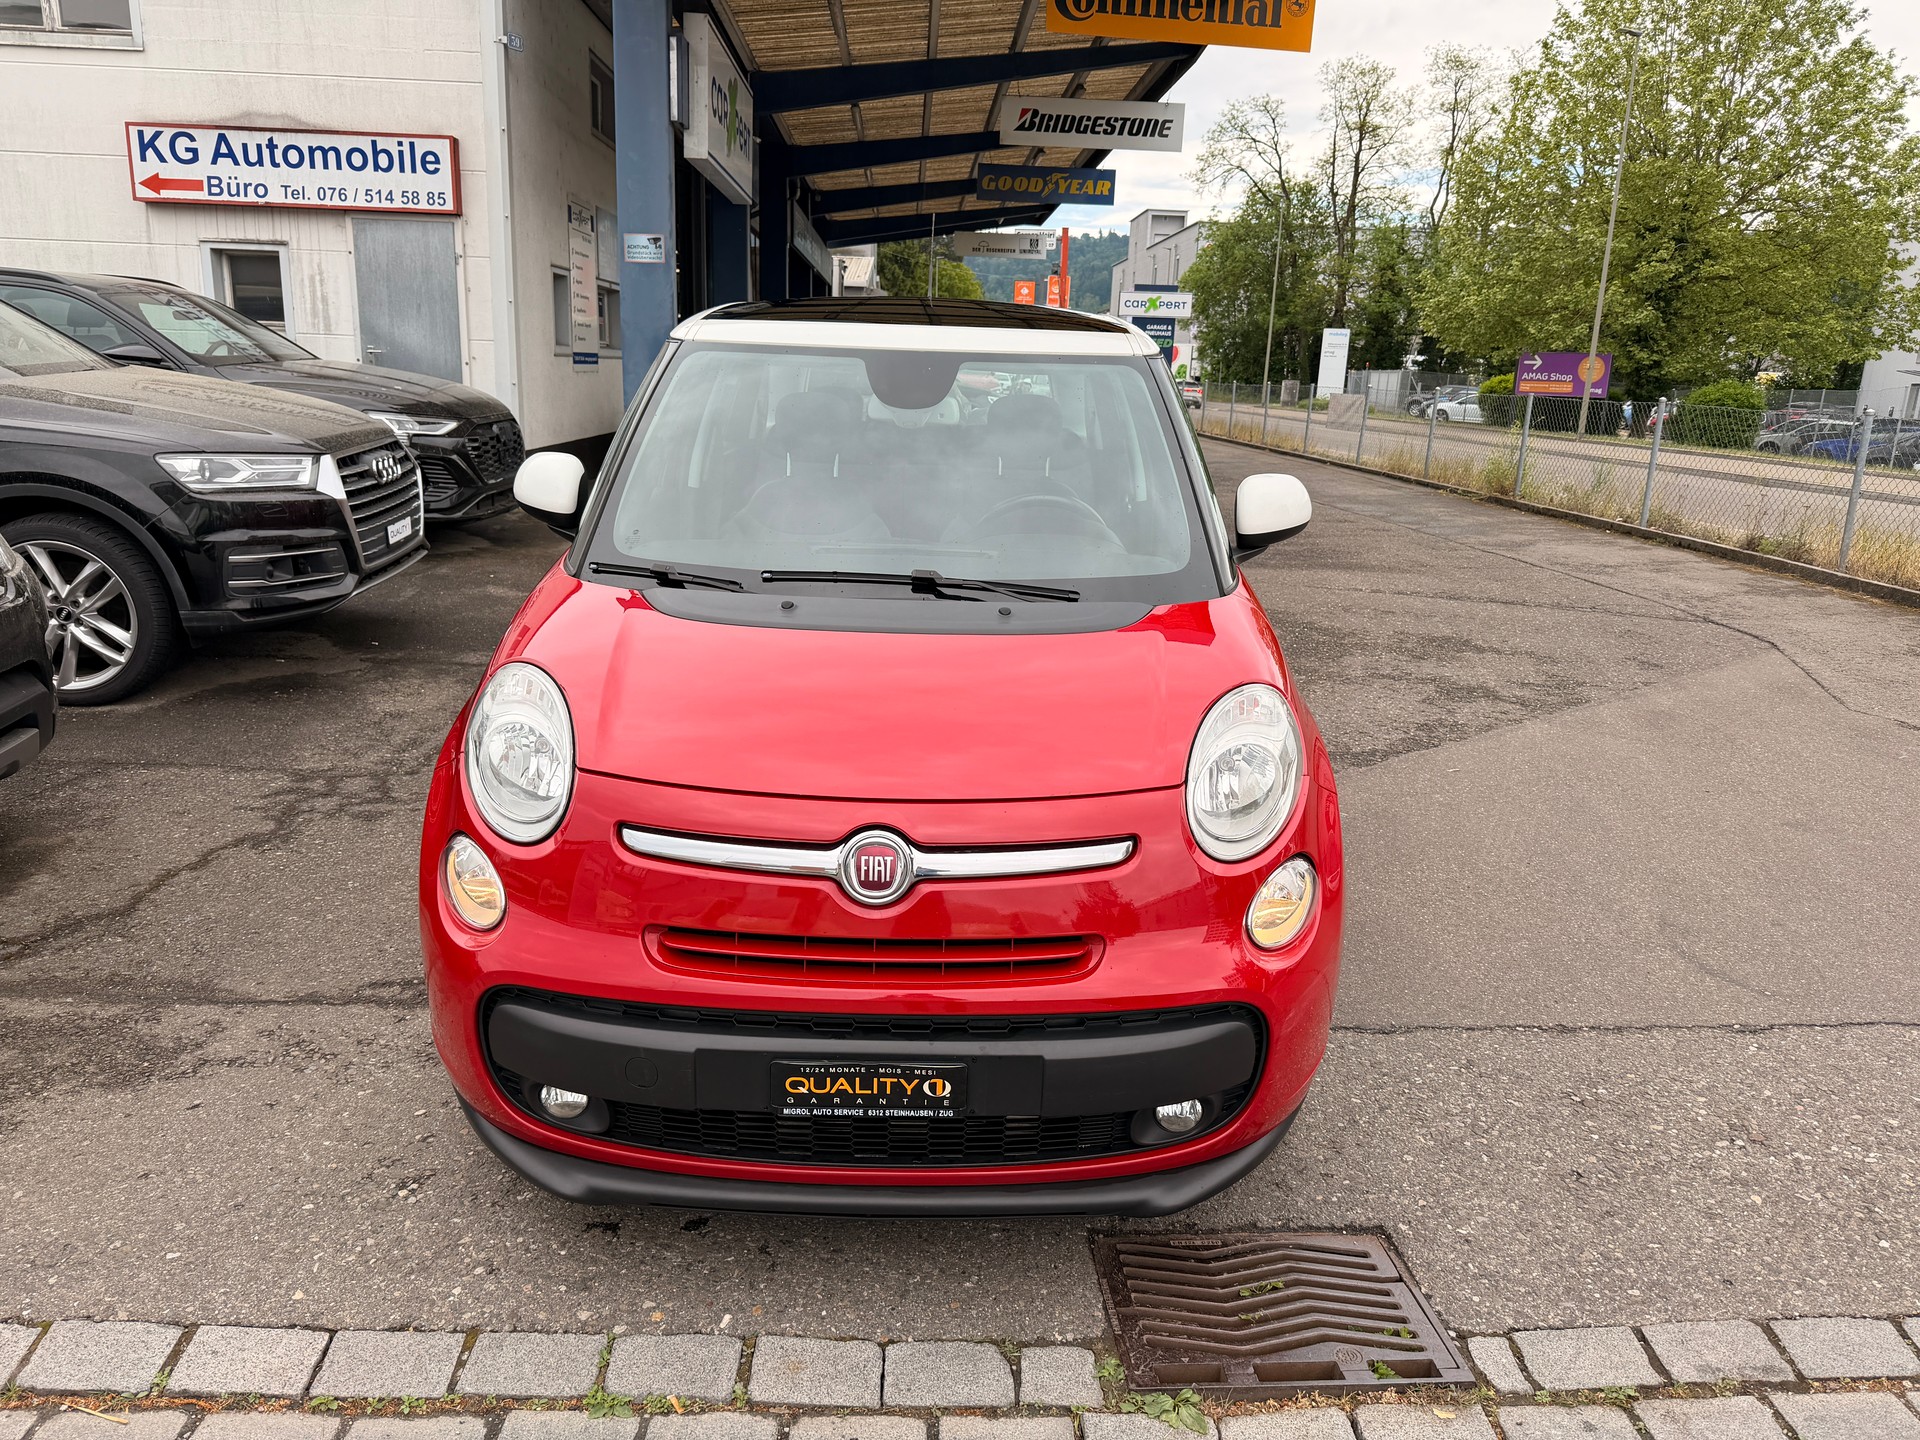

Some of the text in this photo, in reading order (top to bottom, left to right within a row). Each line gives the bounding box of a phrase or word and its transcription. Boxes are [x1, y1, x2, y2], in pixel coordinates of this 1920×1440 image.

[1013, 107, 1174, 138] BRIDGESTONE
[136, 129, 441, 175] KG Automobile
[206, 175, 269, 198] Büro
[280, 184, 311, 200] Tel.
[317, 186, 348, 202] 076
[364, 188, 395, 204] 514
[401, 190, 420, 205] 58
[426, 191, 447, 206] 85
[1154, 338, 1173, 347] ED
[1521, 372, 1573, 382] AMAG Shop
[860, 855, 894, 883] FIAT
[785, 1076, 920, 1095] QUALITY
